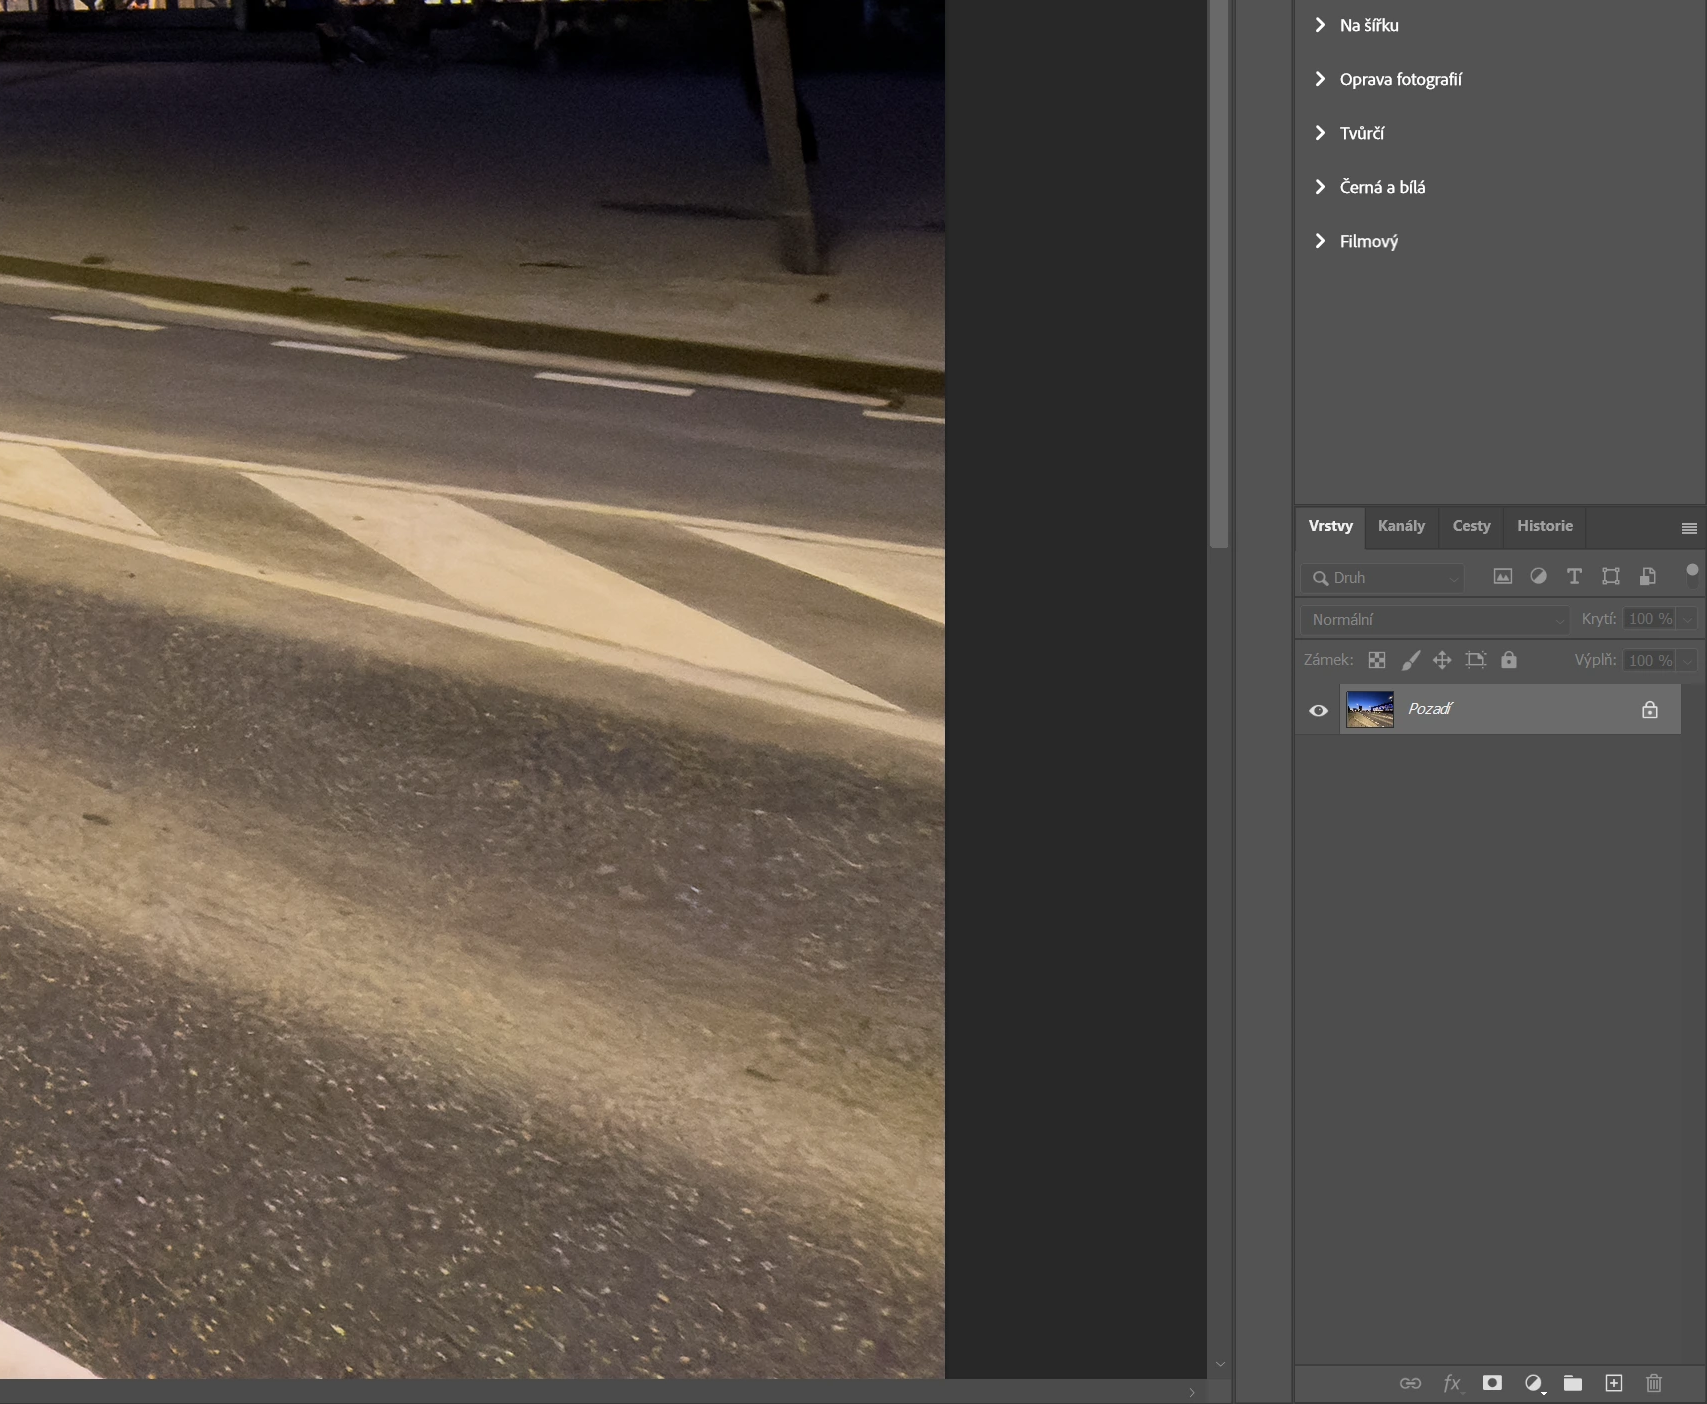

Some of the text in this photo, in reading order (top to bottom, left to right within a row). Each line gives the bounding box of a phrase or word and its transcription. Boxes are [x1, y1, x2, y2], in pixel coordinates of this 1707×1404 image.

[1341, 18, 1398, 32] Na šířku
[1340, 72, 1463, 90] Oprava fotografií
[1340, 126, 1385, 140] Tvůrčí
[1340, 178, 1425, 194] Černá a bílá
[1341, 234, 1398, 251] Filmový
[1309, 520, 1353, 534] Vrstvy
[1379, 520, 1426, 534] Kanály
[1453, 520, 1491, 534] Cesty
[1518, 520, 1573, 531] Historie
[1335, 571, 1365, 583] Druh
[1314, 613, 1374, 625] Normální
[1583, 612, 1616, 627] Krytí:
[1630, 613, 1672, 624] 100 %
[1304, 653, 1353, 665] Zámek:
[1575, 653, 1616, 668] Výplň:
[1630, 655, 1672, 666] 100 %
[1409, 702, 1454, 714] Pozadí
